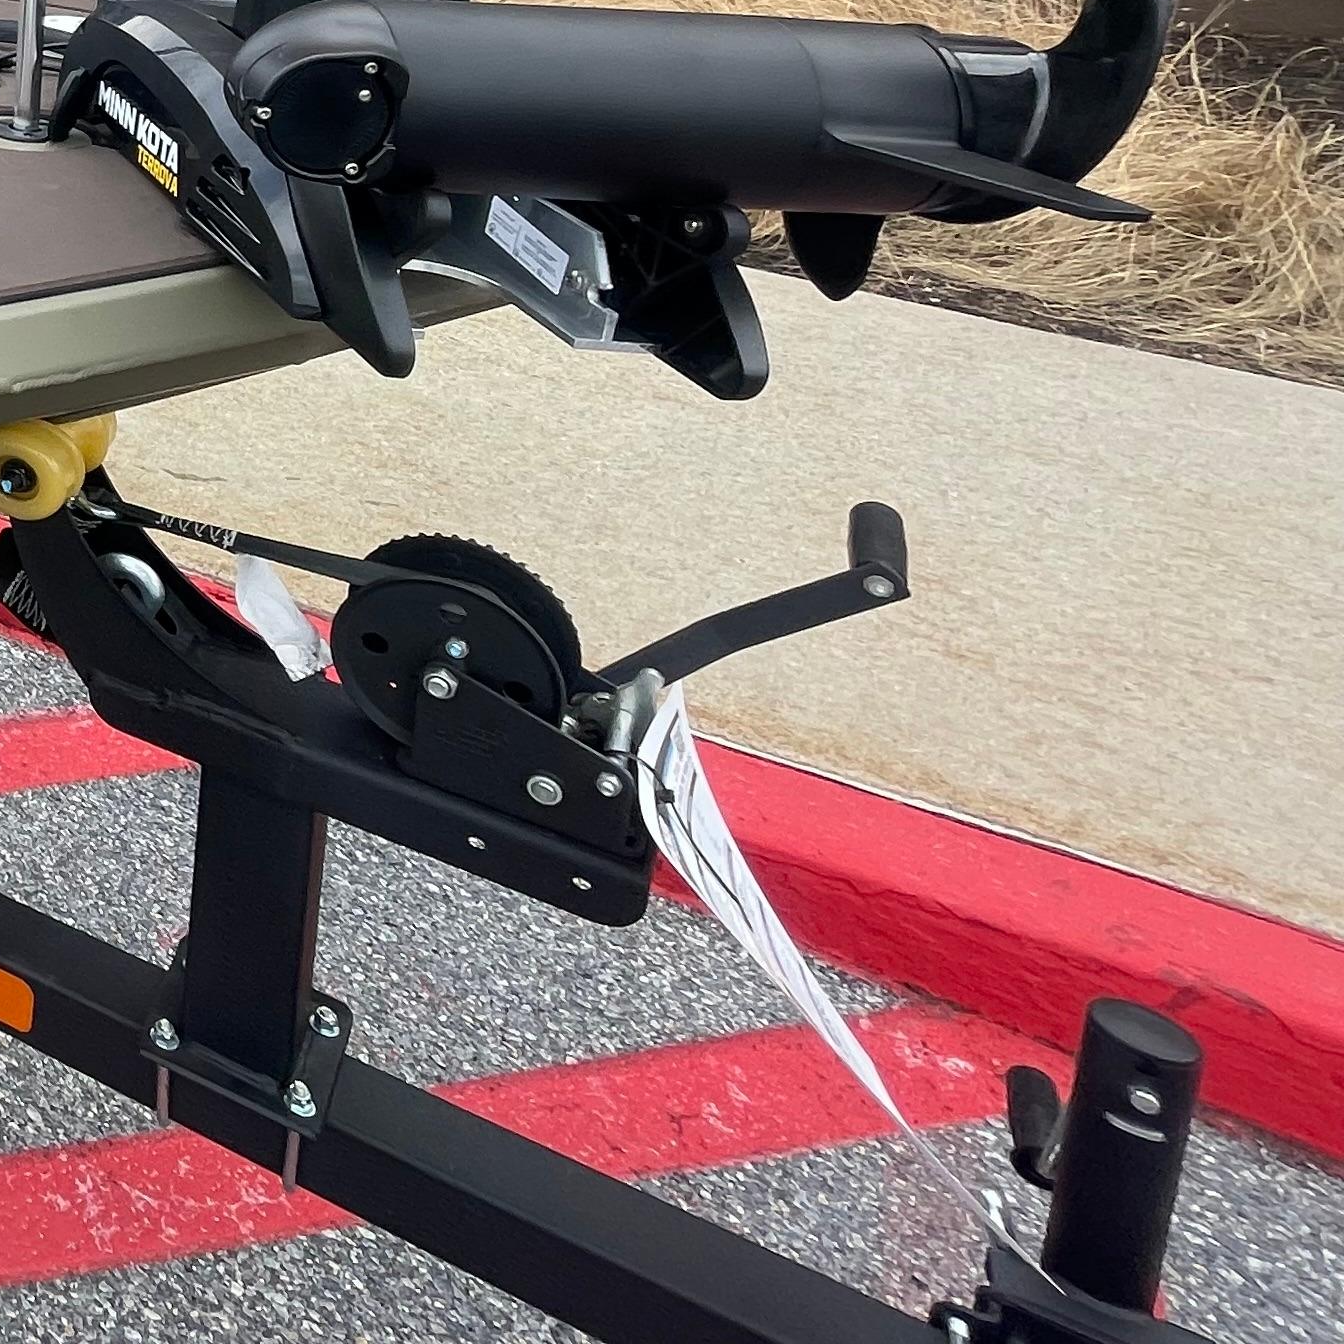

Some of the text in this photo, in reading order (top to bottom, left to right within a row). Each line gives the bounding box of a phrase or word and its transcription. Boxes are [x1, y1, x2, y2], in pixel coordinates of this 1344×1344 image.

[98, 80, 179, 174] MINN KOTA
[137, 144, 178, 197] TERROVA
